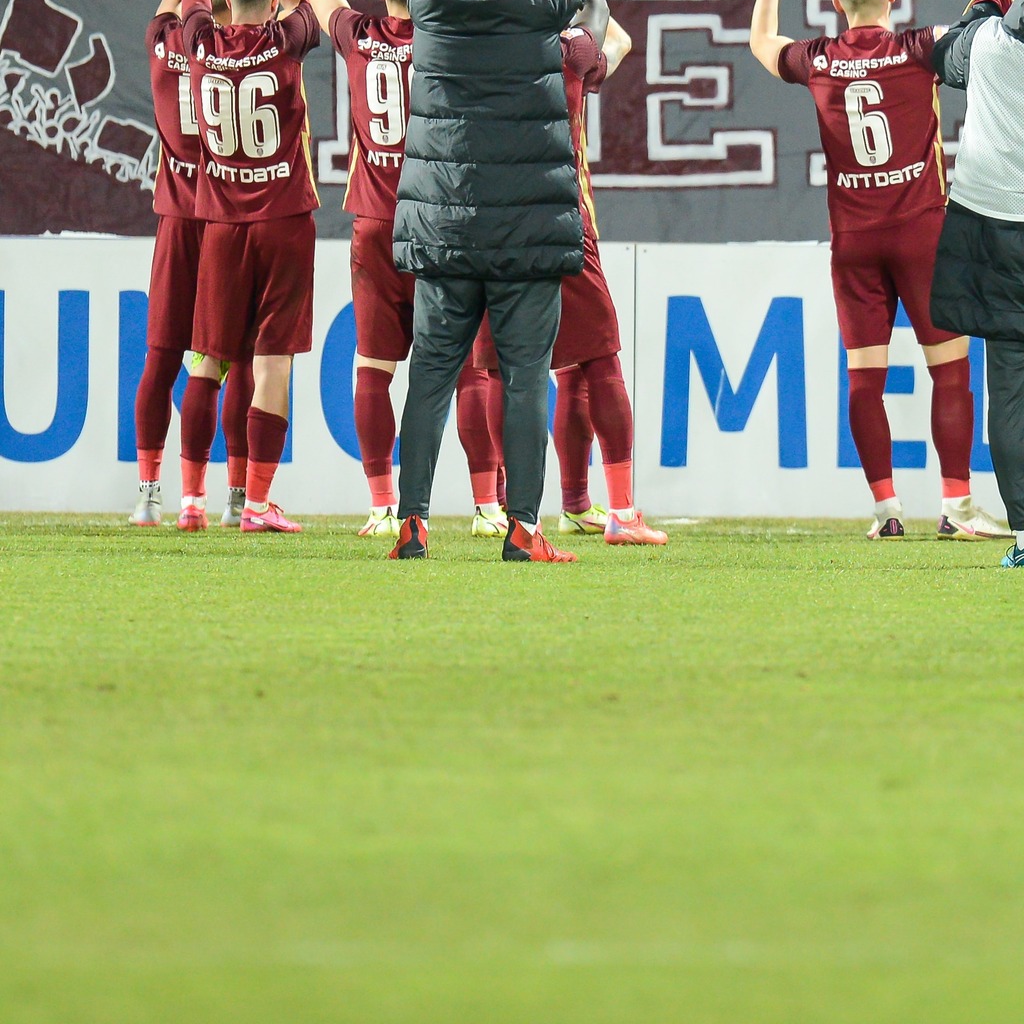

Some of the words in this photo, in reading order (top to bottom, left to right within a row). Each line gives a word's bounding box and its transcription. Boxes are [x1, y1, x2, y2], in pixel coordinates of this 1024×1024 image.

[371, 50, 407, 62] CASINO
[831, 52, 909, 71] POKERSTARS
[830, 69, 868, 79] CASINO
[366, 59, 414, 146] 9
[201, 71, 281, 159] 96
[844, 80, 893, 167] 6
[368, 150, 402, 168] NTT
[205, 160, 238, 182] NTT
[837, 172, 873, 189] NTT
